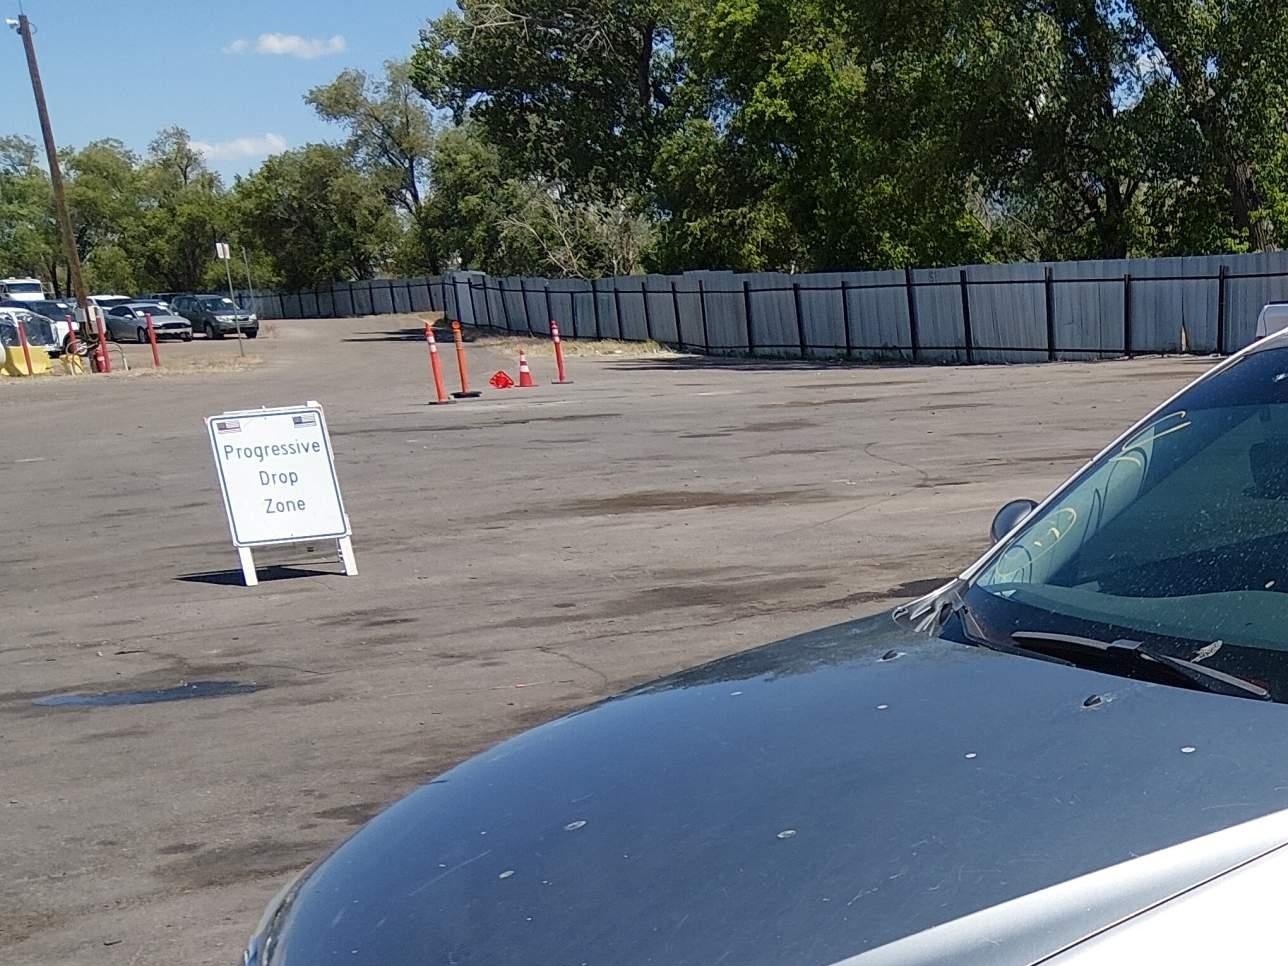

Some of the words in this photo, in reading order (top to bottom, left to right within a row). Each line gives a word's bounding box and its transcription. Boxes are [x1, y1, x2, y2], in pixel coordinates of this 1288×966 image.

[223, 440, 321, 462] Progressive
[259, 471, 298, 486] Drop
[264, 498, 306, 514] Zone
